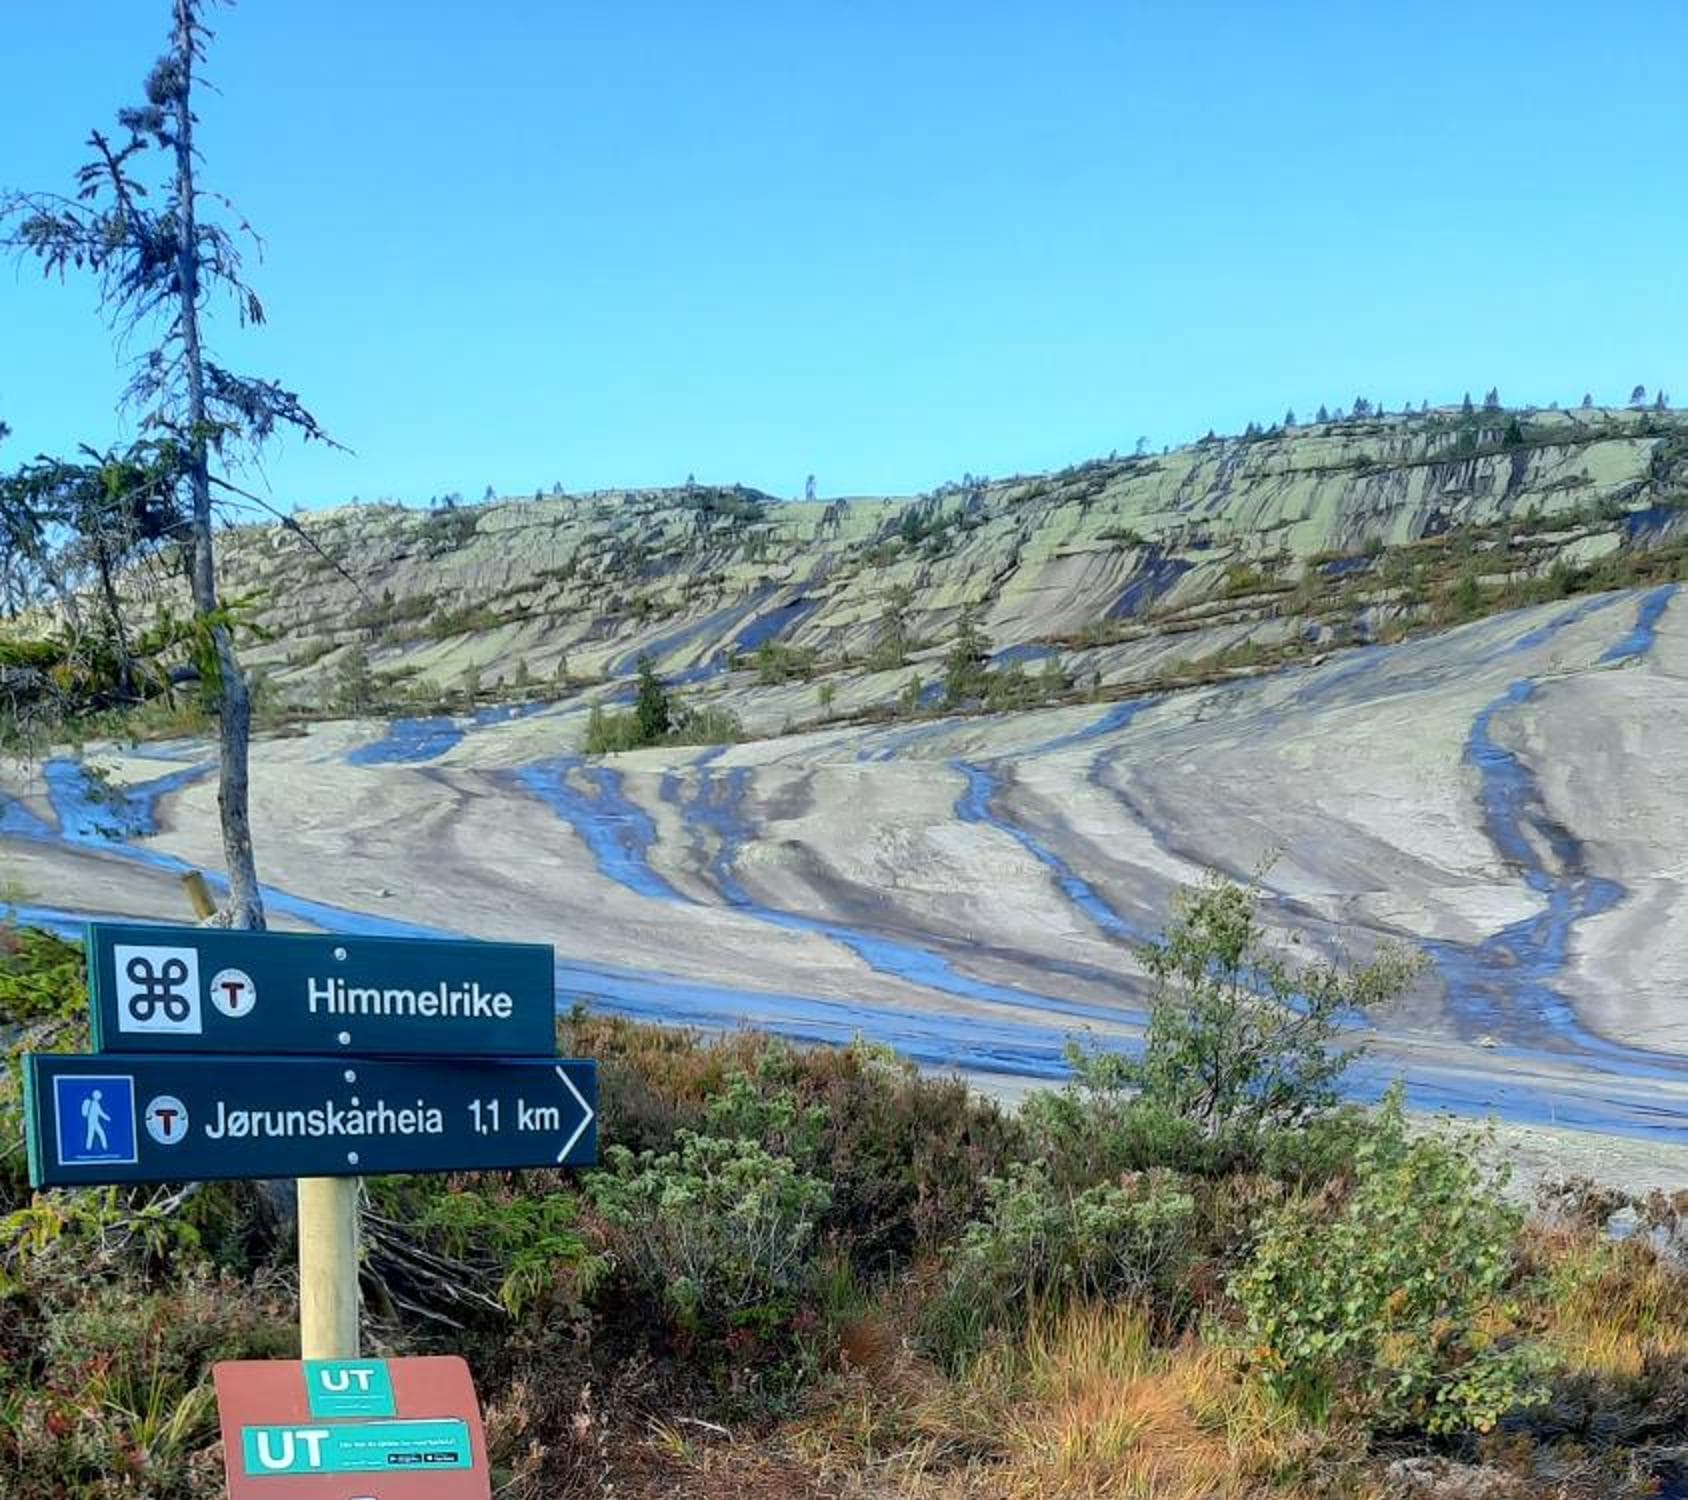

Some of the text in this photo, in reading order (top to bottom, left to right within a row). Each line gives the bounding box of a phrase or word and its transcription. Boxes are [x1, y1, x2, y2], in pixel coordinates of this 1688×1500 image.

[308, 977, 513, 1018] Himmelrike
[205, 1096, 560, 1139] Jørunskårheia 1,1 km
[320, 1369, 374, 1391] UT
[257, 1430, 329, 1469] UT
